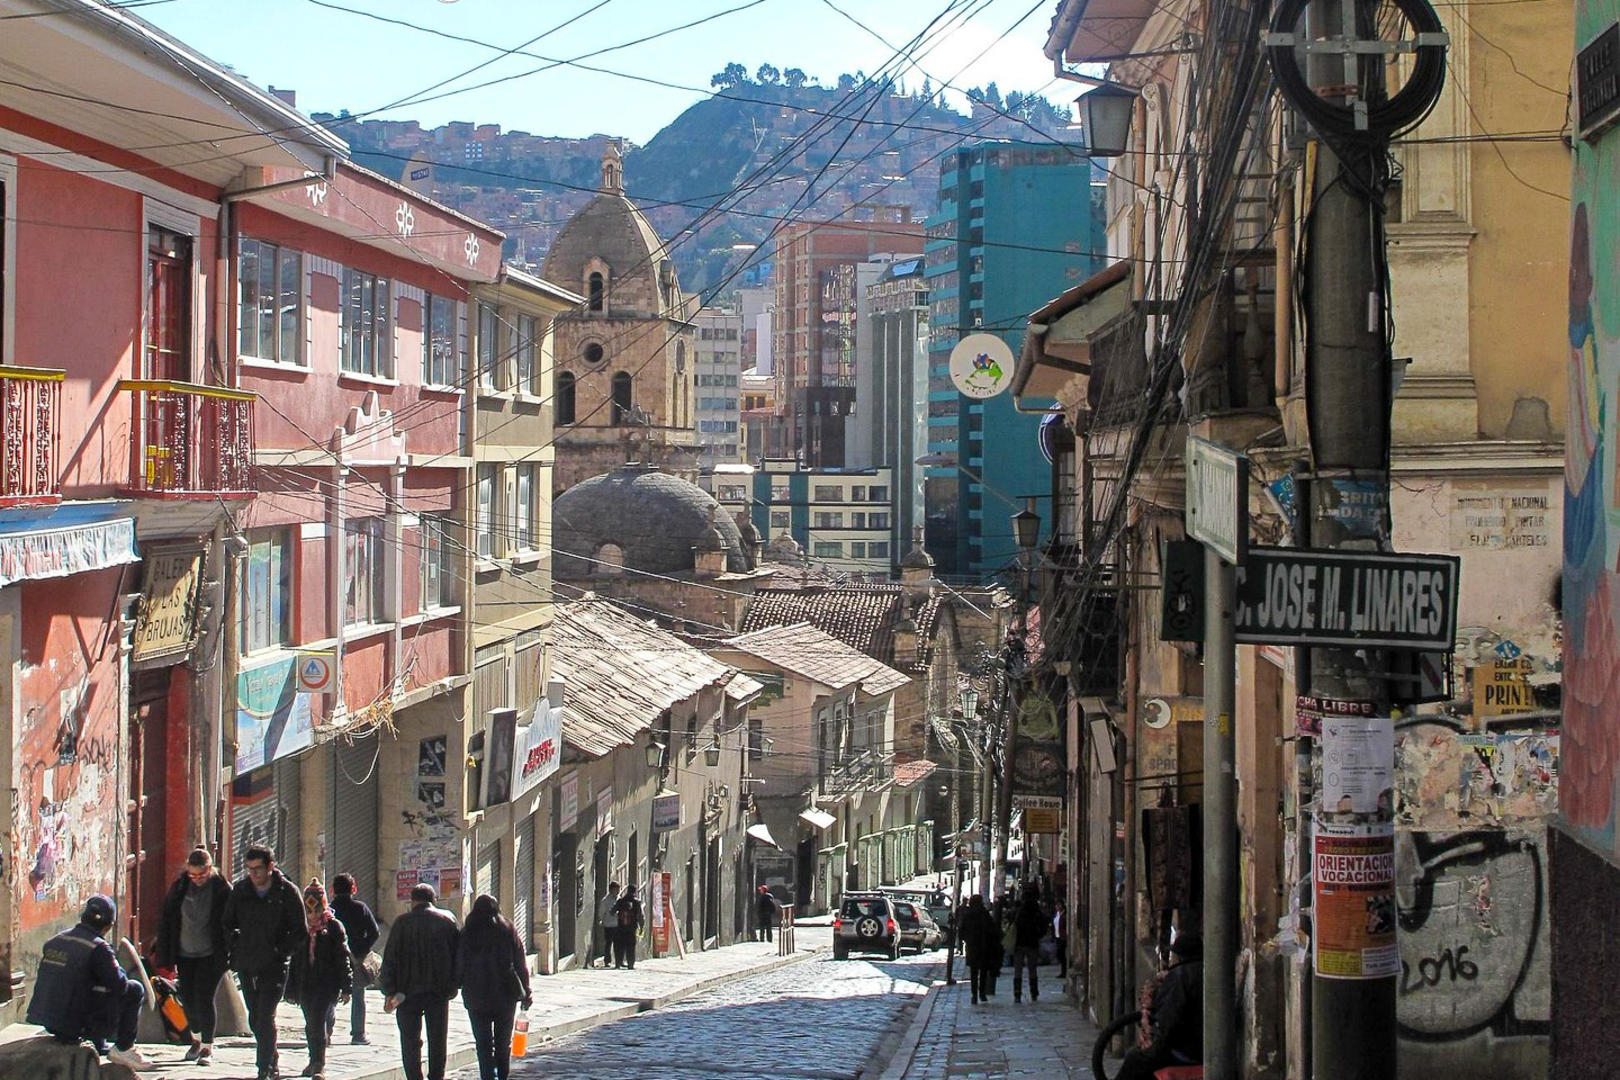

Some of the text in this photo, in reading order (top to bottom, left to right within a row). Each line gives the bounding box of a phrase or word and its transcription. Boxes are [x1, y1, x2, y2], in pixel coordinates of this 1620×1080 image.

[161, 587, 182, 610] LAS
[1257, 562, 1317, 629] JOSE
[1320, 566, 1345, 630] M.
[1351, 567, 1444, 635] LINARES
[145, 614, 185, 643] BRUJAS
[1322, 699, 1374, 714] LIBRE
[1321, 870, 1393, 882] VOCACIONAL
